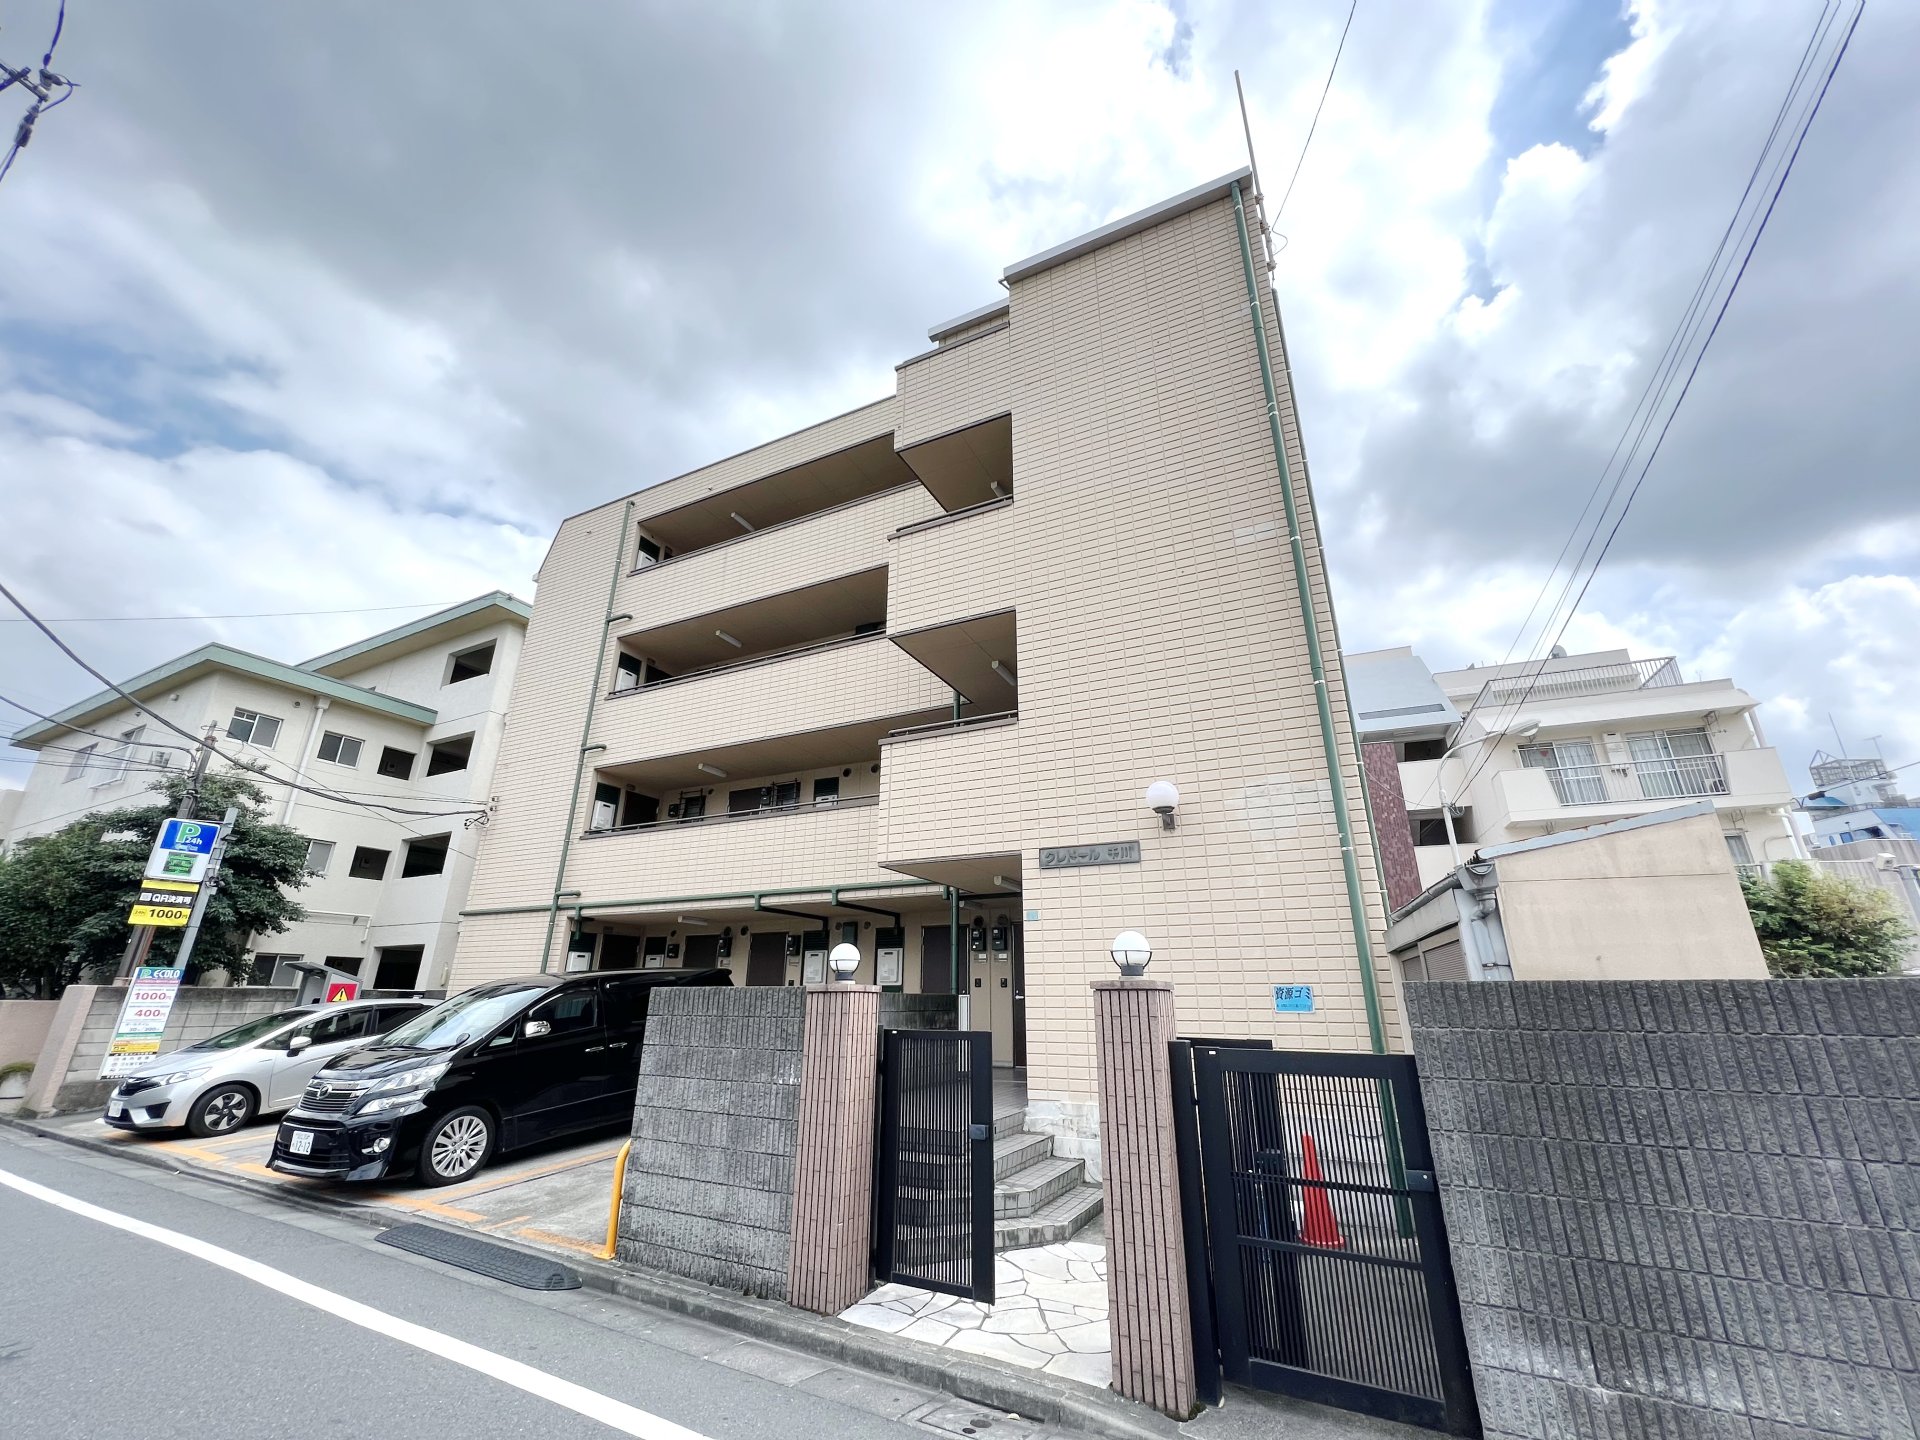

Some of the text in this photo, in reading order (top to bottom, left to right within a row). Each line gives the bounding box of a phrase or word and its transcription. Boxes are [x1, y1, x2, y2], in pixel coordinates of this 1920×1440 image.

[176, 822, 202, 843] P
[186, 836, 203, 845] 24h
[152, 893, 193, 905] QR決済可
[153, 969, 181, 979] ECOLO
[1275, 986, 1311, 1000] 資源ゴミ
